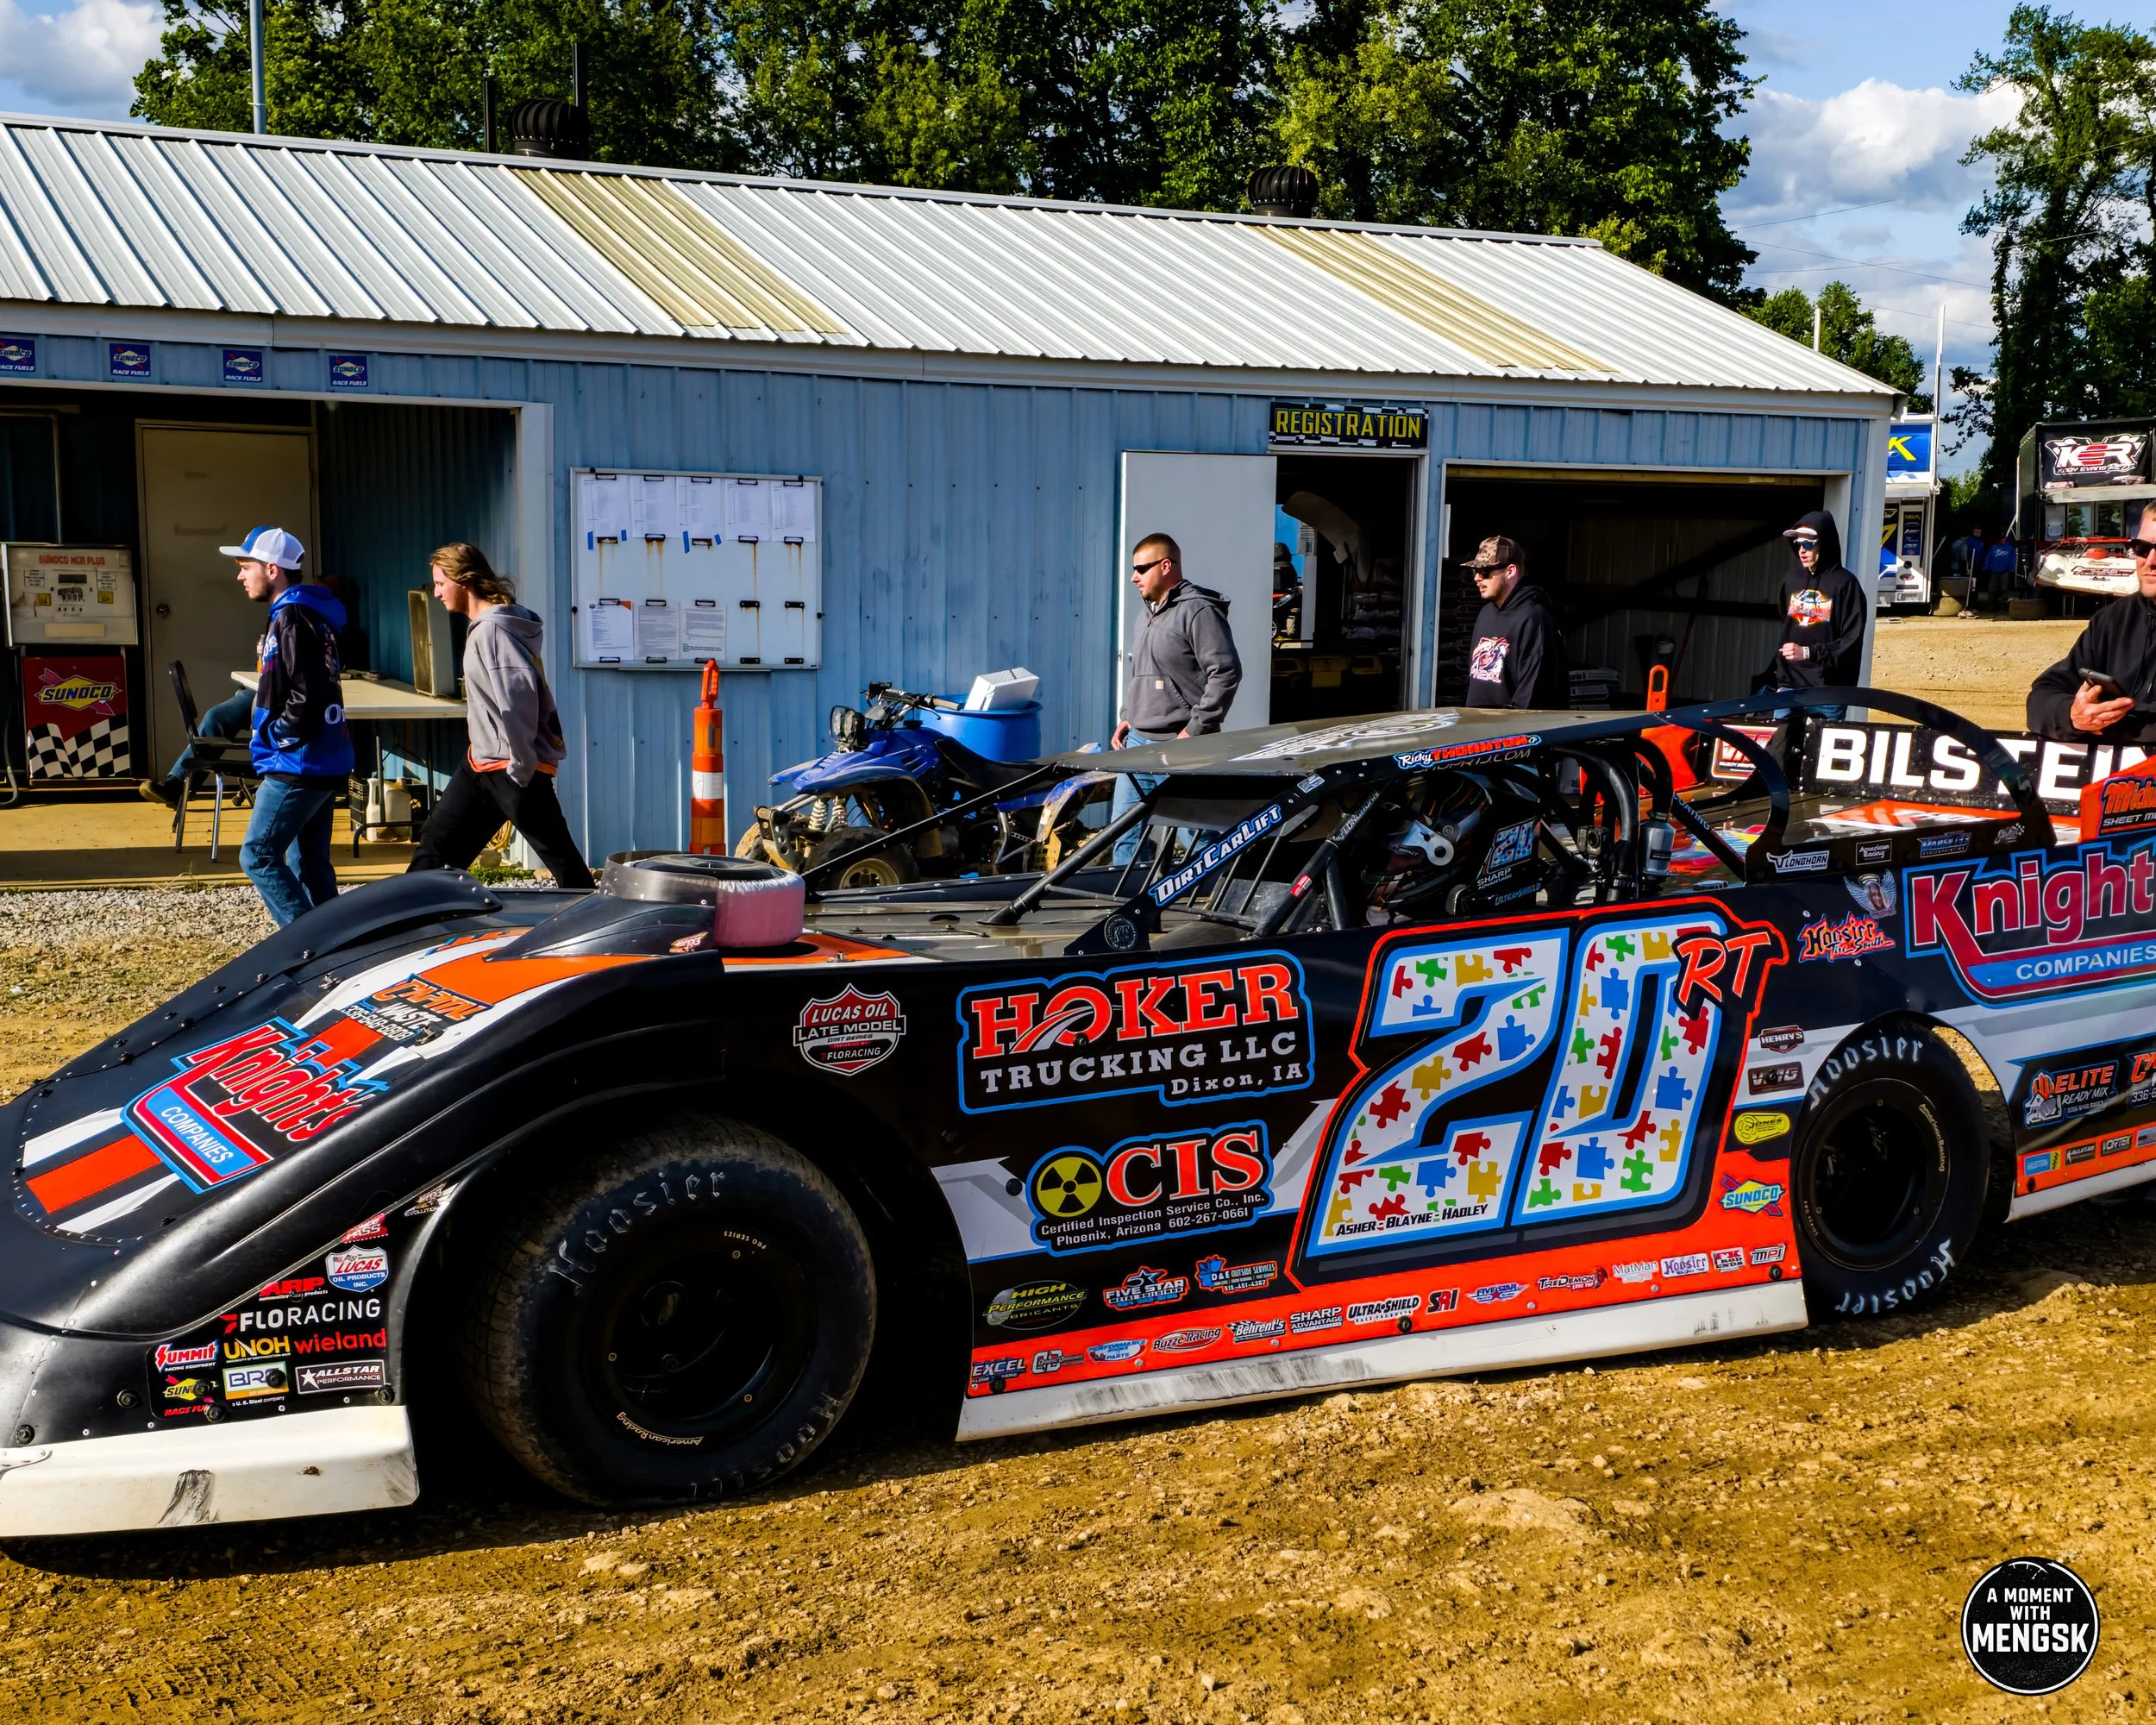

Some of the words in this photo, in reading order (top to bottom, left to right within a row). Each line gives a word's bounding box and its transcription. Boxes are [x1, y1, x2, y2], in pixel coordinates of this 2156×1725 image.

[115, 354, 147, 362] SUNOCO
[227, 361, 259, 369] SUNOCO
[1275, 409, 1421, 438] REGISTRATION
[43, 686, 113, 700] SUNOCO
[1397, 753, 1432, 766] Ricky
[2103, 813, 2143, 826] SHEET
[1785, 854, 1828, 868] LONGHORN
[1476, 868, 1512, 887] SHARP
[1805, 920, 1874, 955] Hoosier
[1677, 932, 1771, 1007] RT
[812, 1005, 862, 1024] LUCAS
[865, 1002, 888, 1019] OIL
[971, 963, 1299, 1059] HOKER
[798, 1025, 840, 1042] LATE
[843, 1019, 902, 1034] MODEL
[826, 1047, 881, 1061] FLORACING
[981, 1044, 1206, 1094] TRUCKING
[1219, 1032, 1296, 1063] LLC
[1171, 1072, 1263, 1095] Dixon,
[1274, 1063, 1303, 1082] IA
[1306, 912, 1727, 1258] 20
[2055, 1064, 2115, 1095] ELITE
[2061, 1089, 2091, 1105] READY
[2091, 1087, 2109, 1099] MIX
[161, 1106, 235, 1164] COMPANIES
[1106, 1130, 1264, 1208] CIS
[1725, 1184, 1781, 1206] SUNOCO
[1041, 1218, 1094, 1236] Certified
[1099, 1208, 1163, 1227] Inspection
[1166, 1200, 1211, 1216] Service
[1243, 1192, 1265, 1205] Inc.
[1336, 1221, 1377, 1236] ASHER
[1385, 1212, 1433, 1229] BLAYNE
[1442, 1204, 1489, 1220] HADLEY
[723, 1229, 750, 1242] SERIES
[1056, 1230, 1112, 1246] Phoenix,
[1116, 1221, 1162, 1239] Arizona
[1169, 1208, 1249, 1229] 602-267-0661
[751, 1238, 768, 1251] PRO
[1755, 1248, 1783, 1262] MPI
[335, 1258, 383, 1274] LUCAS
[1613, 1261, 1658, 1275] MatMan
[1664, 1257, 1707, 1275] Hoosier
[347, 1271, 385, 1282] PRODUCTS
[1211, 1272, 1218, 1281] D
[1225, 1270, 1231, 1279] E
[259, 1276, 325, 1296] ARP
[1011, 1283, 1066, 1299] HIGH
[1106, 1287, 1141, 1300] FIVE
[1144, 1279, 1185, 1294] STAR
[987, 1291, 1085, 1314] PERFORMANCE
[240, 1298, 381, 1333] FLORACING
[1289, 1307, 1343, 1323] SHARP
[1291, 1315, 1344, 1330] ADVANTAGE
[1186, 1327, 1221, 1344] Racing
[1235, 1319, 1284, 1337] Behrent's
[223, 1335, 291, 1360] UNOH
[293, 1328, 387, 1354] wieland
[316, 1365, 380, 1377] ALLSTAR
[972, 1358, 1026, 1377] EXCEL
[317, 1374, 381, 1384] PERFORMANCE
[616, 1411, 649, 1440] Racing
[649, 1433, 705, 1447] American
